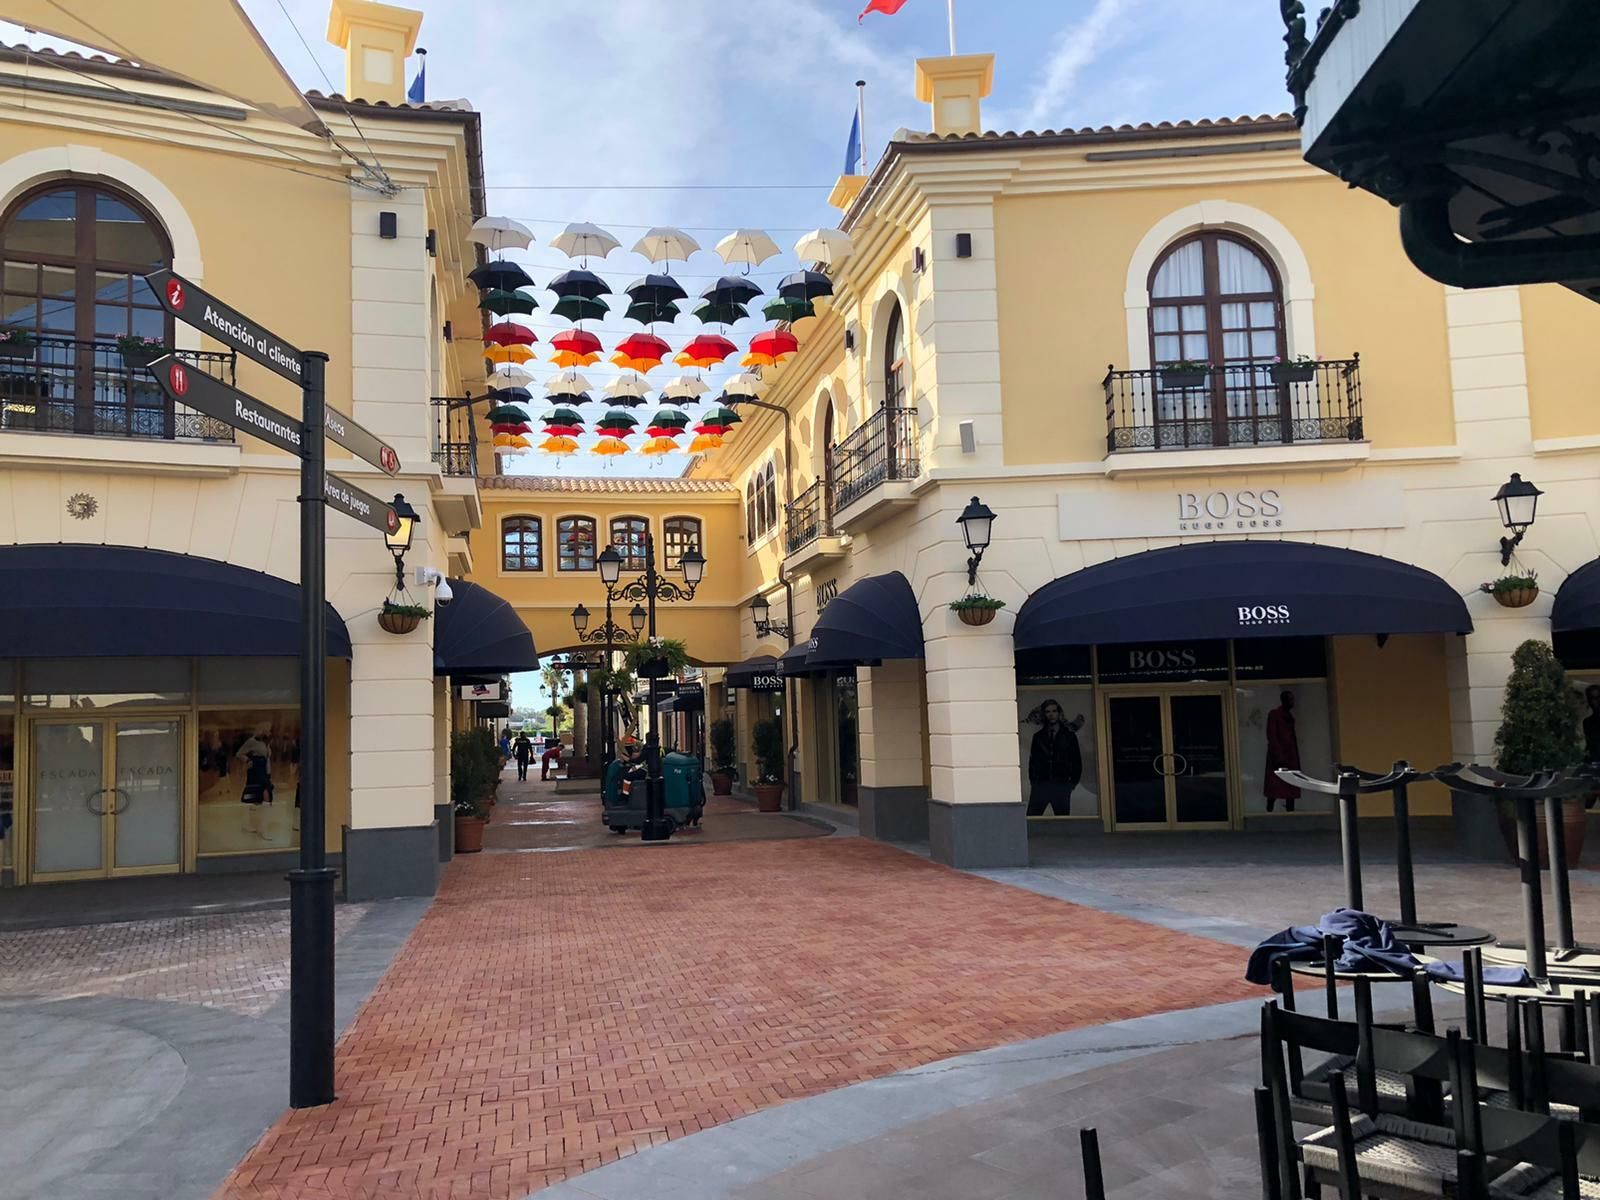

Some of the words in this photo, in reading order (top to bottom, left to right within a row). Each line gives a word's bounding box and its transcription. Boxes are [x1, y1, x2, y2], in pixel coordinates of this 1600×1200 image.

[204, 305, 255, 348] Atención
[257, 339, 267, 355] al
[269, 347, 301, 375] cliente
[235, 399, 301, 446] Restaurantes
[325, 413, 345, 437] Aseos
[324, 475, 340, 499] Área
[341, 488, 349, 504] de
[350, 492, 370, 515] juegos
[1177, 489, 1282, 520] BOSS
[1237, 604, 1290, 621] BOSS
[1128, 648, 1197, 669] BOSS
[753, 675, 784, 686] BOSS
[39, 767, 97, 779] ESCADA
[120, 766, 173, 777] ESCADA
